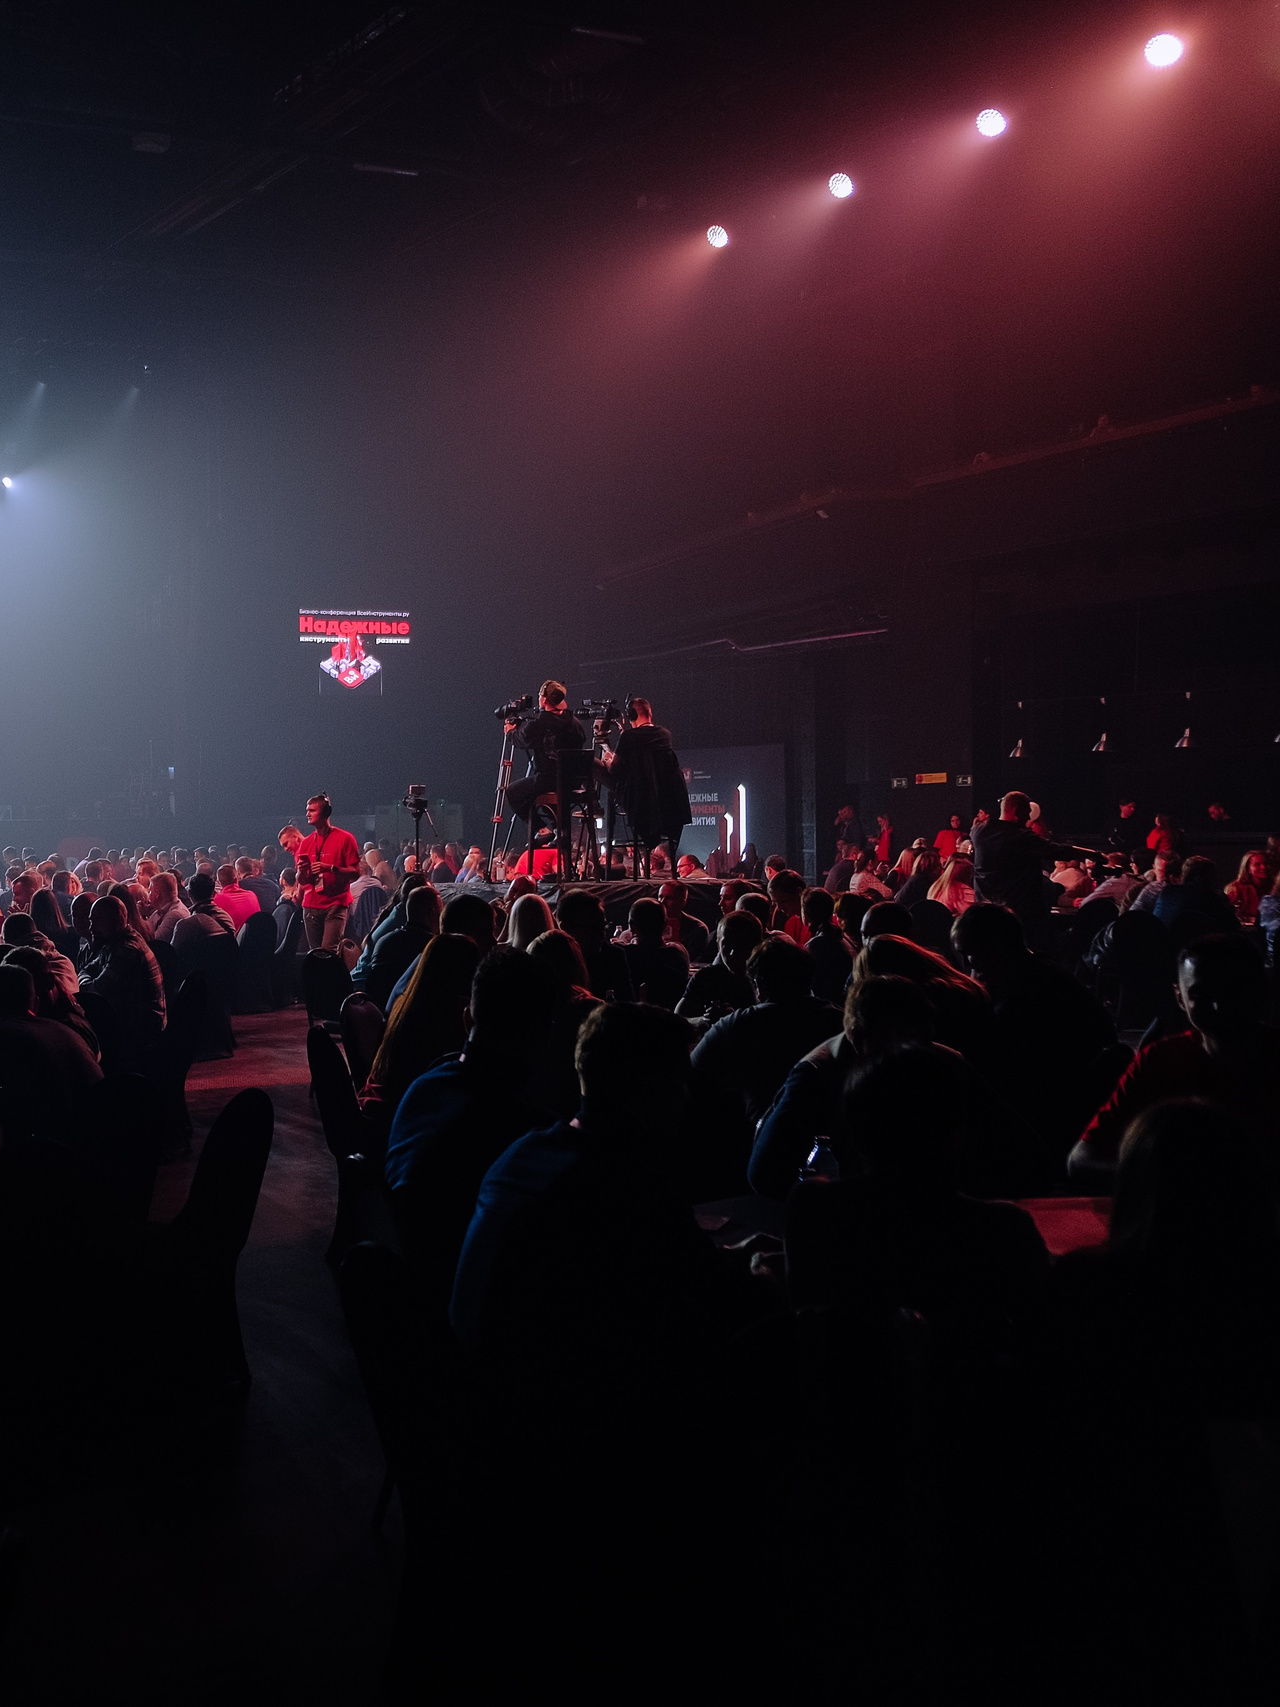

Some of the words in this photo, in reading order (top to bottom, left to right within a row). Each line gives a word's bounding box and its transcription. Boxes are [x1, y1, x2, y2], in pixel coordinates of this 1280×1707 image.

[299, 615, 410, 635] Надежные
[376, 637, 410, 645] развития
[688, 793, 719, 803] ЕЖНЫЕ
[688, 816, 716, 826] ВИТИЯ
